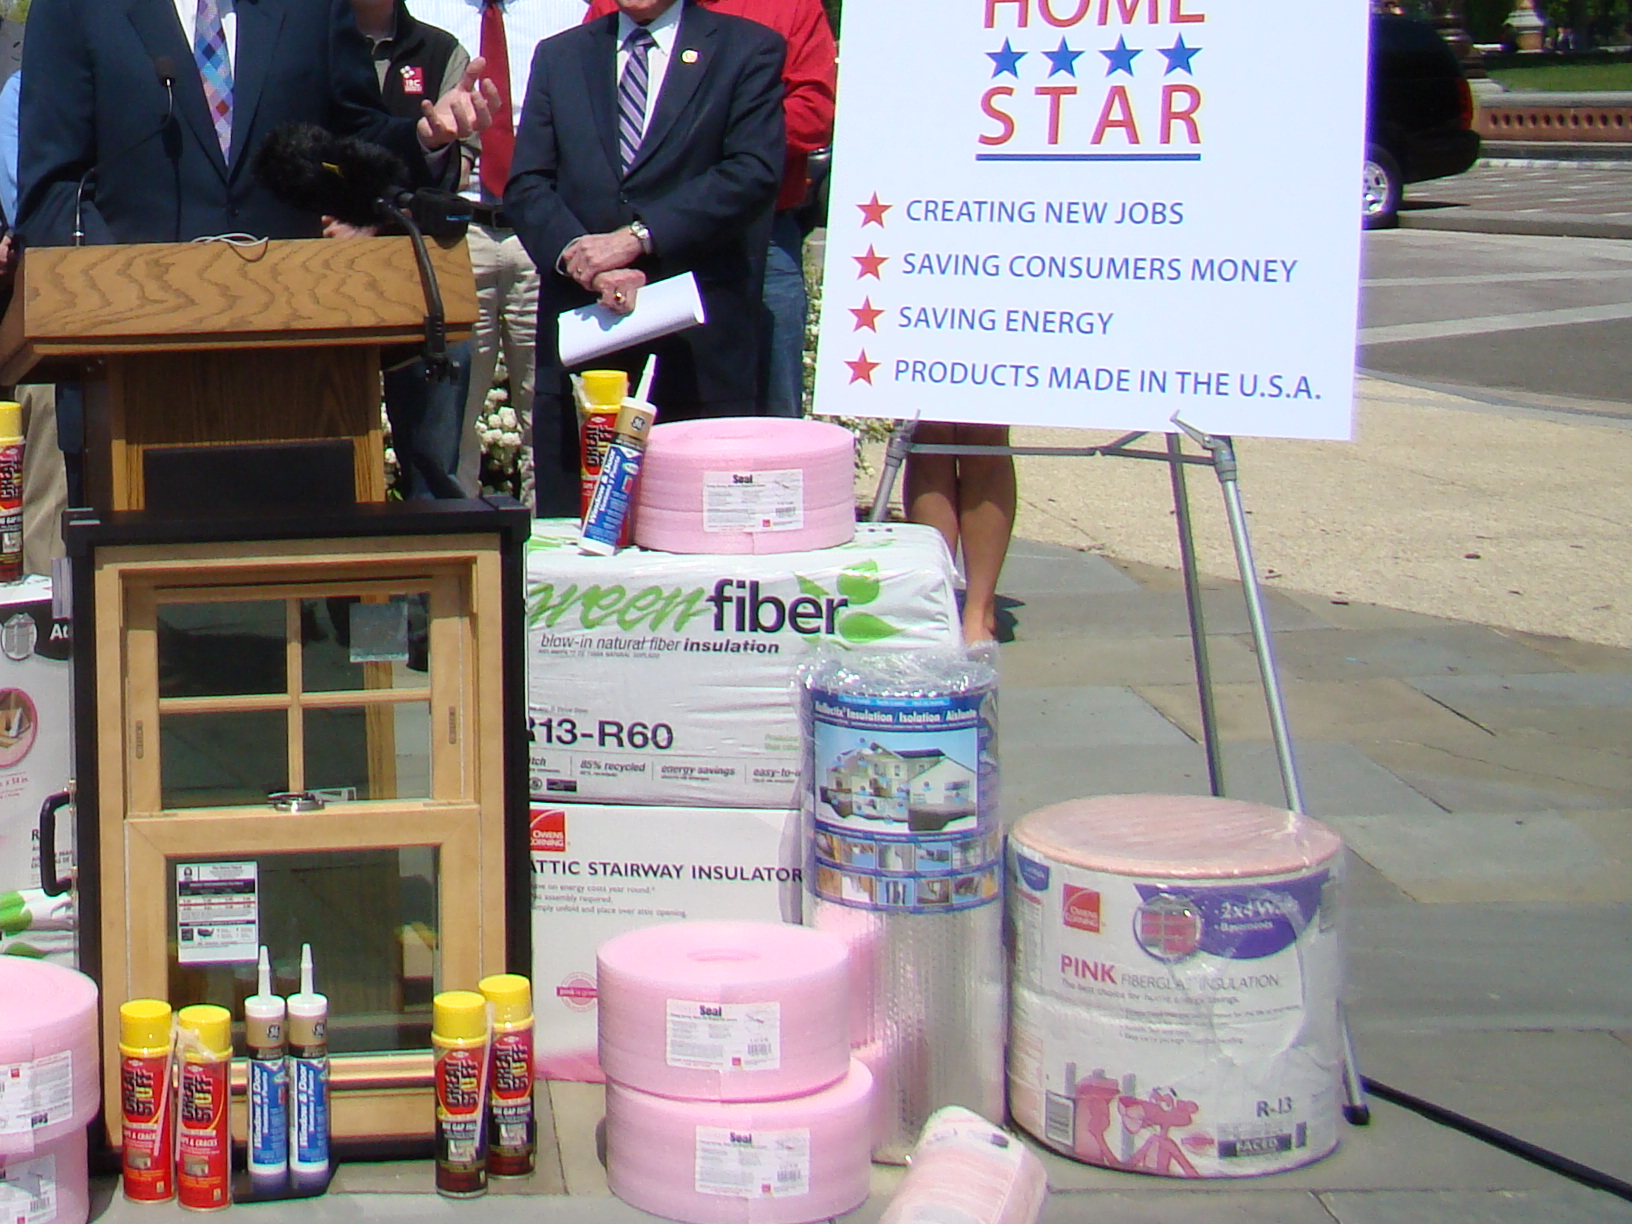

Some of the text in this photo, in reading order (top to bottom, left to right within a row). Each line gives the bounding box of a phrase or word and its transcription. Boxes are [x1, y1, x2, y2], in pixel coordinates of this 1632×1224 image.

[977, 84, 1201, 145] STAR
[906, 200, 1184, 225] CREATING NEW JOBS
[902, 253, 1298, 283] SAVING CONSUMERS MONEY
[898, 306, 1114, 335] SAVING ENERGY
[894, 360, 1322, 400] PRODUCTS MADE IN THE U.S.A.
[589, 482, 605, 523] Window
[604, 448, 616, 474] Door
[733, 474, 753, 484] Seal
[705, 579, 848, 634] fiber
[541, 635, 779, 654] blow-in natural fiber insulation
[846, 708, 894, 722] Insulation
[899, 711, 941, 723] Isolation
[580, 759, 646, 772] 85% recycled
[661, 765, 736, 776] energy savings
[532, 830, 563, 838] OWENS
[588, 861, 685, 880] STAIRWAY
[691, 864, 803, 883] INSULATOR
[544, 893, 577, 903] assembly
[559, 883, 585, 893] energy
[587, 884, 607, 892] costs
[608, 885, 624, 894] year
[581, 905, 595, 913] and
[596, 906, 616, 915] place
[1060, 953, 1118, 985] PINK
[1198, 972, 1280, 991] INSULATION
[1078, 982, 1094, 994] best
[699, 1005, 723, 1017] Seal
[299, 1064, 307, 1091] Door
[1255, 1096, 1292, 1117] R-13
[254, 1104, 262, 1148] Window
[299, 1104, 308, 1147] Window
[138, 1132, 157, 1141] CRACK
[730, 1132, 752, 1144] Seal
